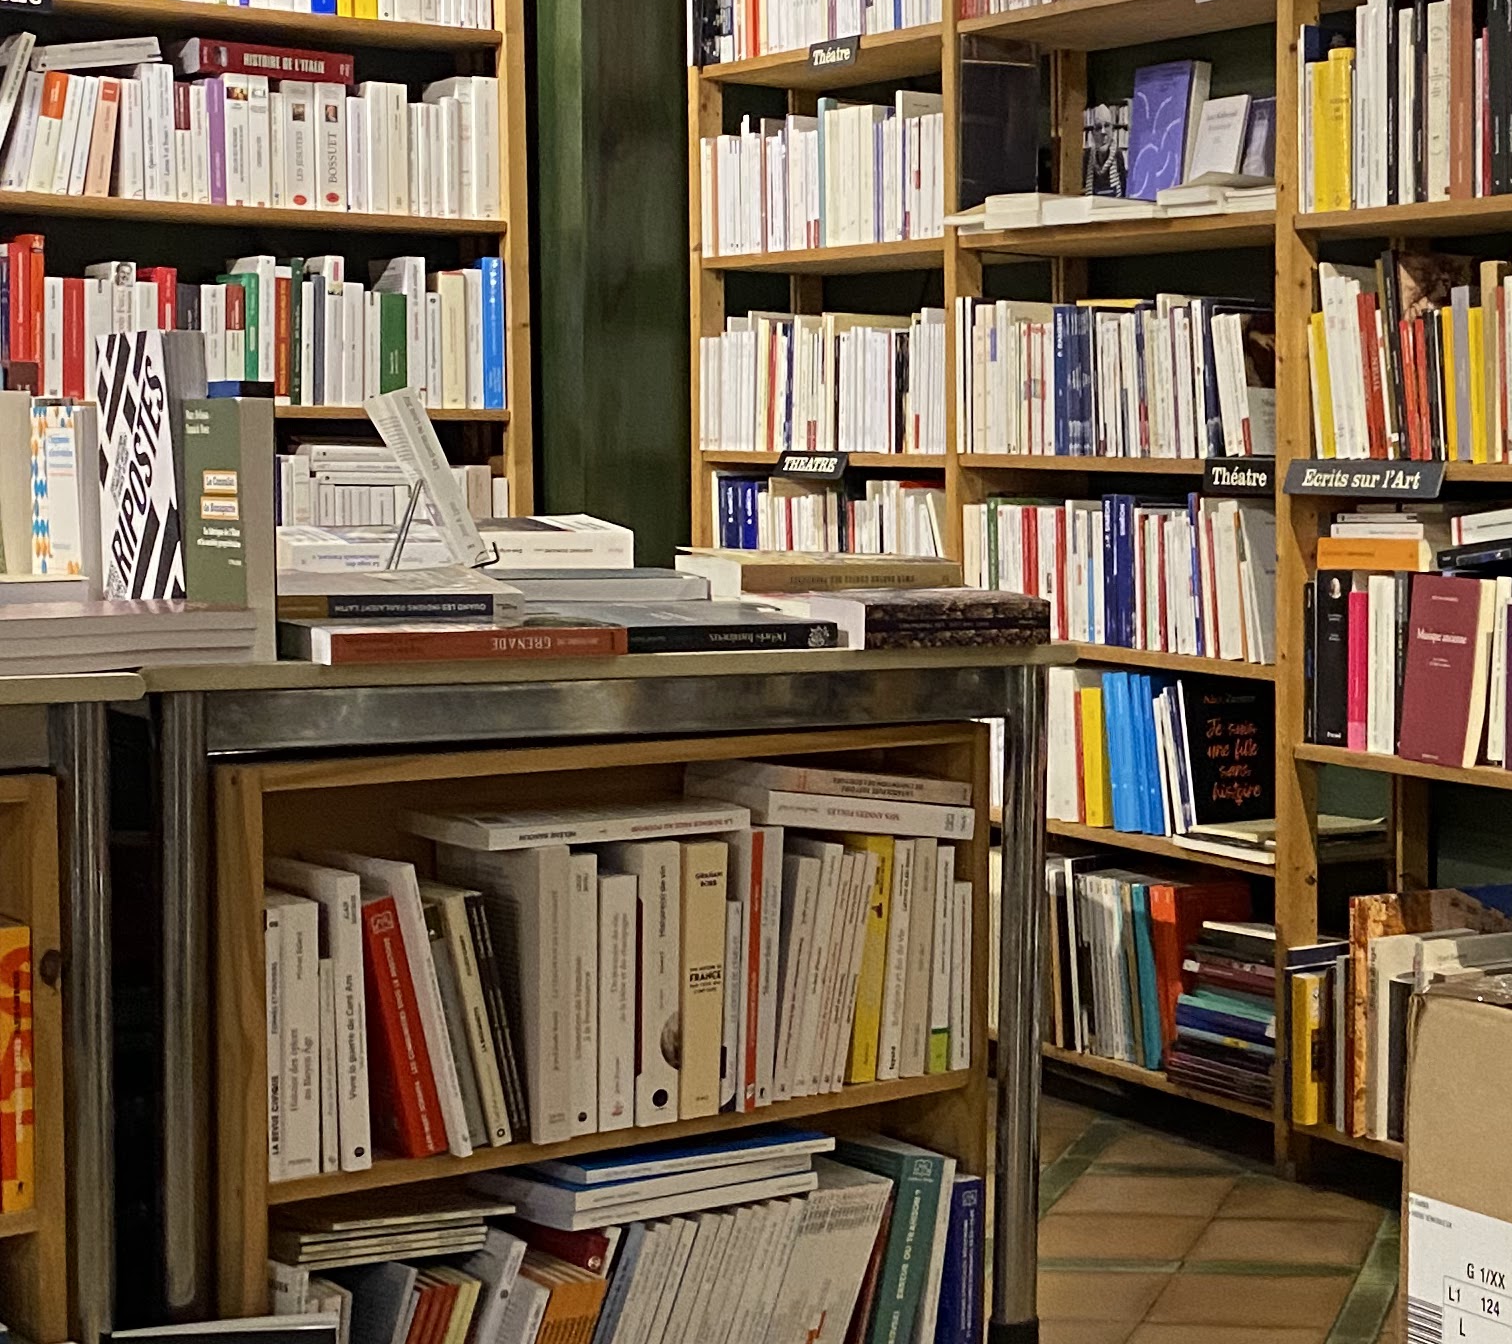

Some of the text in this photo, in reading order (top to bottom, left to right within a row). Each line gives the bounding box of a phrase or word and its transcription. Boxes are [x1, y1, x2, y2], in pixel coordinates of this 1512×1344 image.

[282, 57, 293, 70] DE
[328, 132, 338, 183] BOSSUET
[111, 355, 164, 587] RIPOSTES
[1302, 468, 1421, 490] Ecrits sur l'Art
[490, 635, 553, 651] GRENADE
[1212, 783, 1262, 806] histoire
[695, 871, 724, 882] GRAHAM
[689, 969, 723, 985] FRANCE
[343, 974, 358, 1099] Vivre guerre Cent Ans
[272, 1144, 279, 1155] LA
[1466, 1263, 1475, 1281] G
[1480, 1266, 1506, 1290] 1/XX
[1448, 1285, 1501, 1317] L1 124
[1459, 1318, 1466, 1337] L
